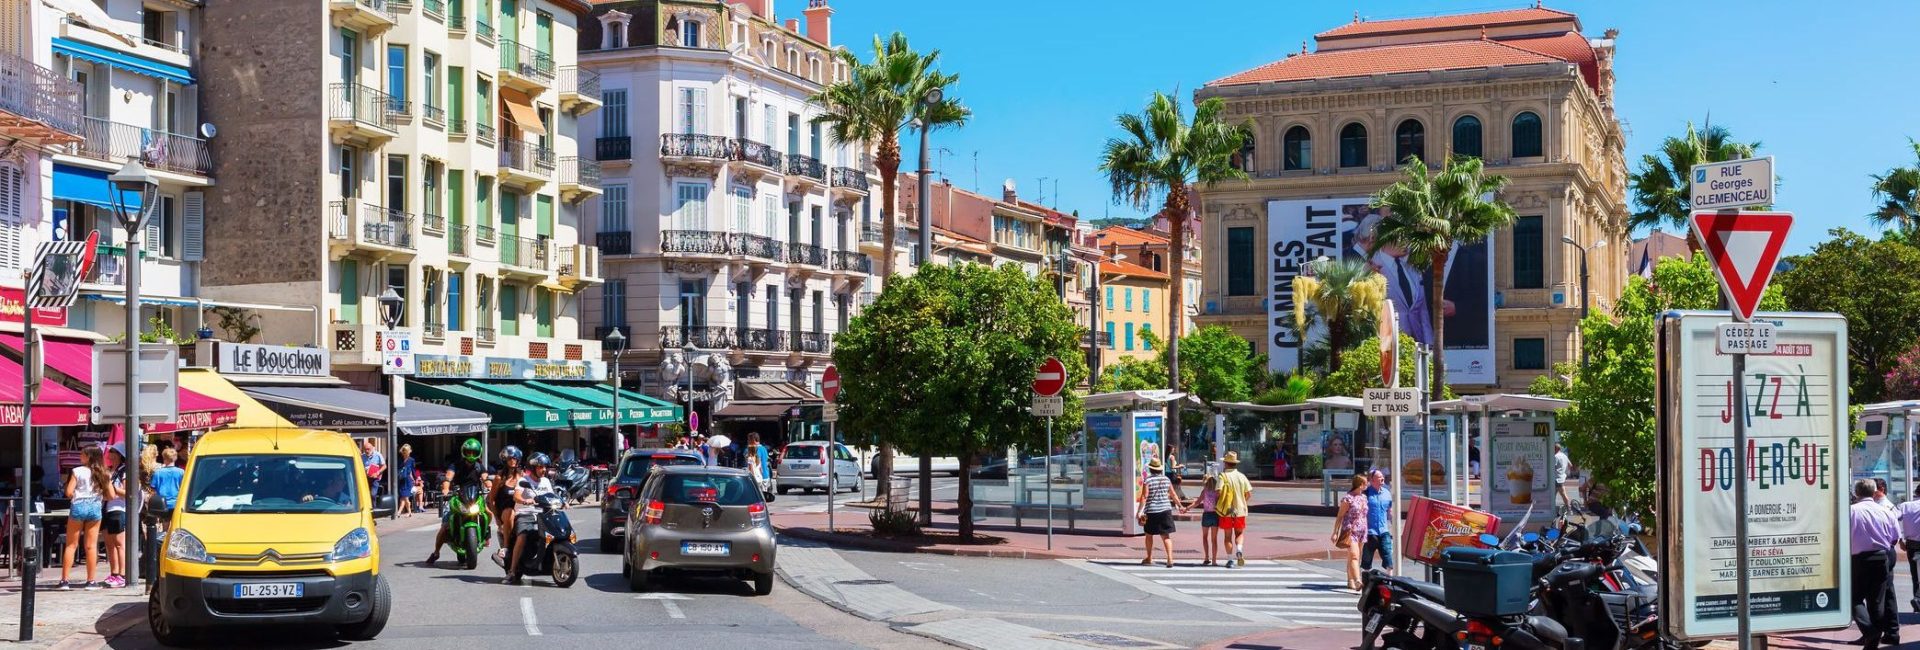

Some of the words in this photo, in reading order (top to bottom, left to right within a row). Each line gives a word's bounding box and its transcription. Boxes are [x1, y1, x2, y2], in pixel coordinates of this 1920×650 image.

[1721, 165, 1742, 177] RUE
[1711, 179, 1753, 190] Georges
[1696, 189, 1767, 206] CLEMENCEAU
[1274, 240, 1305, 348] CANNES
[1725, 326, 1754, 338] CÉDEZ
[1759, 328, 1769, 338] LE
[1727, 340, 1767, 349] PASSAGE
[1796, 345, 1810, 355] 2016
[235, 346, 252, 368] LE
[258, 347, 322, 370] BOUCHON
[1369, 391, 1391, 400] SAUF
[1394, 391, 1412, 400] BUS
[1796, 364, 1811, 417] À
[607, 409, 623, 420] PIAZA
[1372, 404, 1382, 413] ET
[1386, 404, 1409, 413] TAXIS
[1754, 504, 1782, 516] DOMERGUE
[1786, 503, 1797, 515] 21H
[1747, 537, 1771, 547] MBERT
[1771, 537, 1778, 545] &
[1778, 536, 1799, 545] KAROL
[1799, 535, 1819, 544] BEFFA
[1751, 548, 1767, 557] ÉRIC
[1767, 545, 1784, 556] SÉVA
[1724, 558, 1754, 568] LAUT
[1755, 556, 1793, 567] COULONDRE
[1752, 566, 1780, 577] BARNES
[1780, 566, 1786, 576] &
[1786, 564, 1813, 575] EQUINOX
[242, 585, 295, 597] DL-253-VZ
